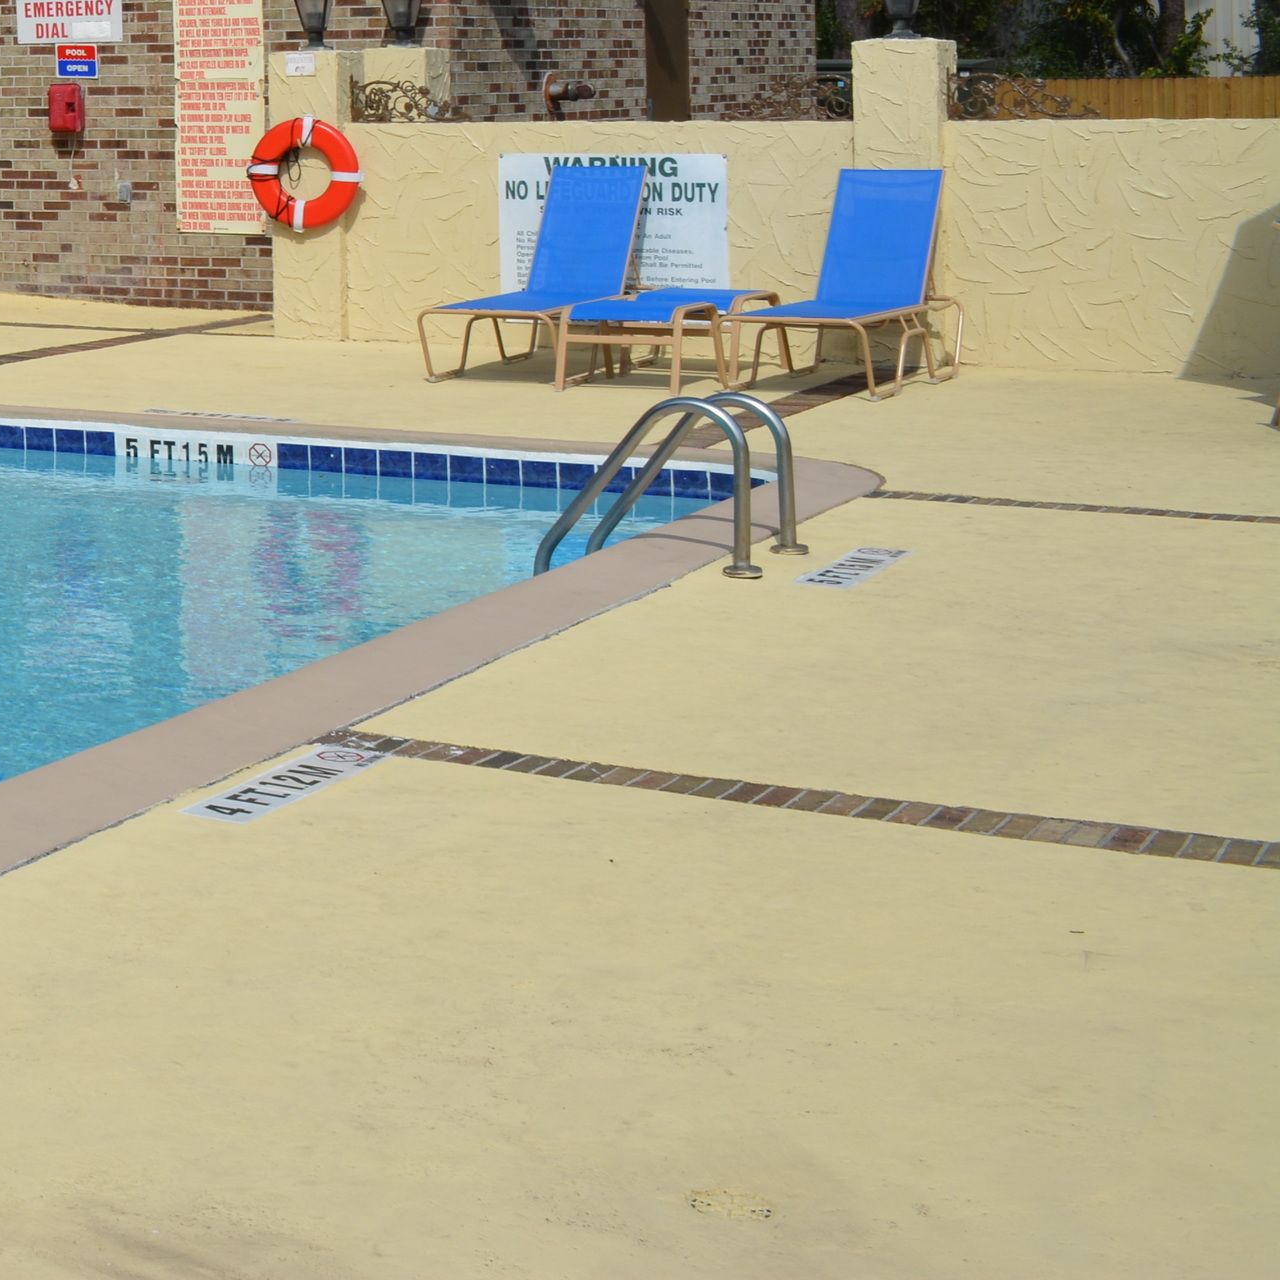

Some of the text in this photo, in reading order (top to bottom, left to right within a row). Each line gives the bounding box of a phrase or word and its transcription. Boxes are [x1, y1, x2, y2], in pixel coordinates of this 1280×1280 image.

[24, 0, 113, 18] EMERGENCY
[36, 22, 69, 39] DIAL
[65, 48, 87, 56] POOL
[66, 64, 89, 72] OPEN
[506, 180, 529, 201] NO
[642, 182, 664, 203] ON
[672, 182, 720, 203] DUTY
[657, 207, 683, 216] RISK
[126, 437, 138, 458] 5
[205, 804, 254, 816] 4
[288, 764, 344, 780] M
